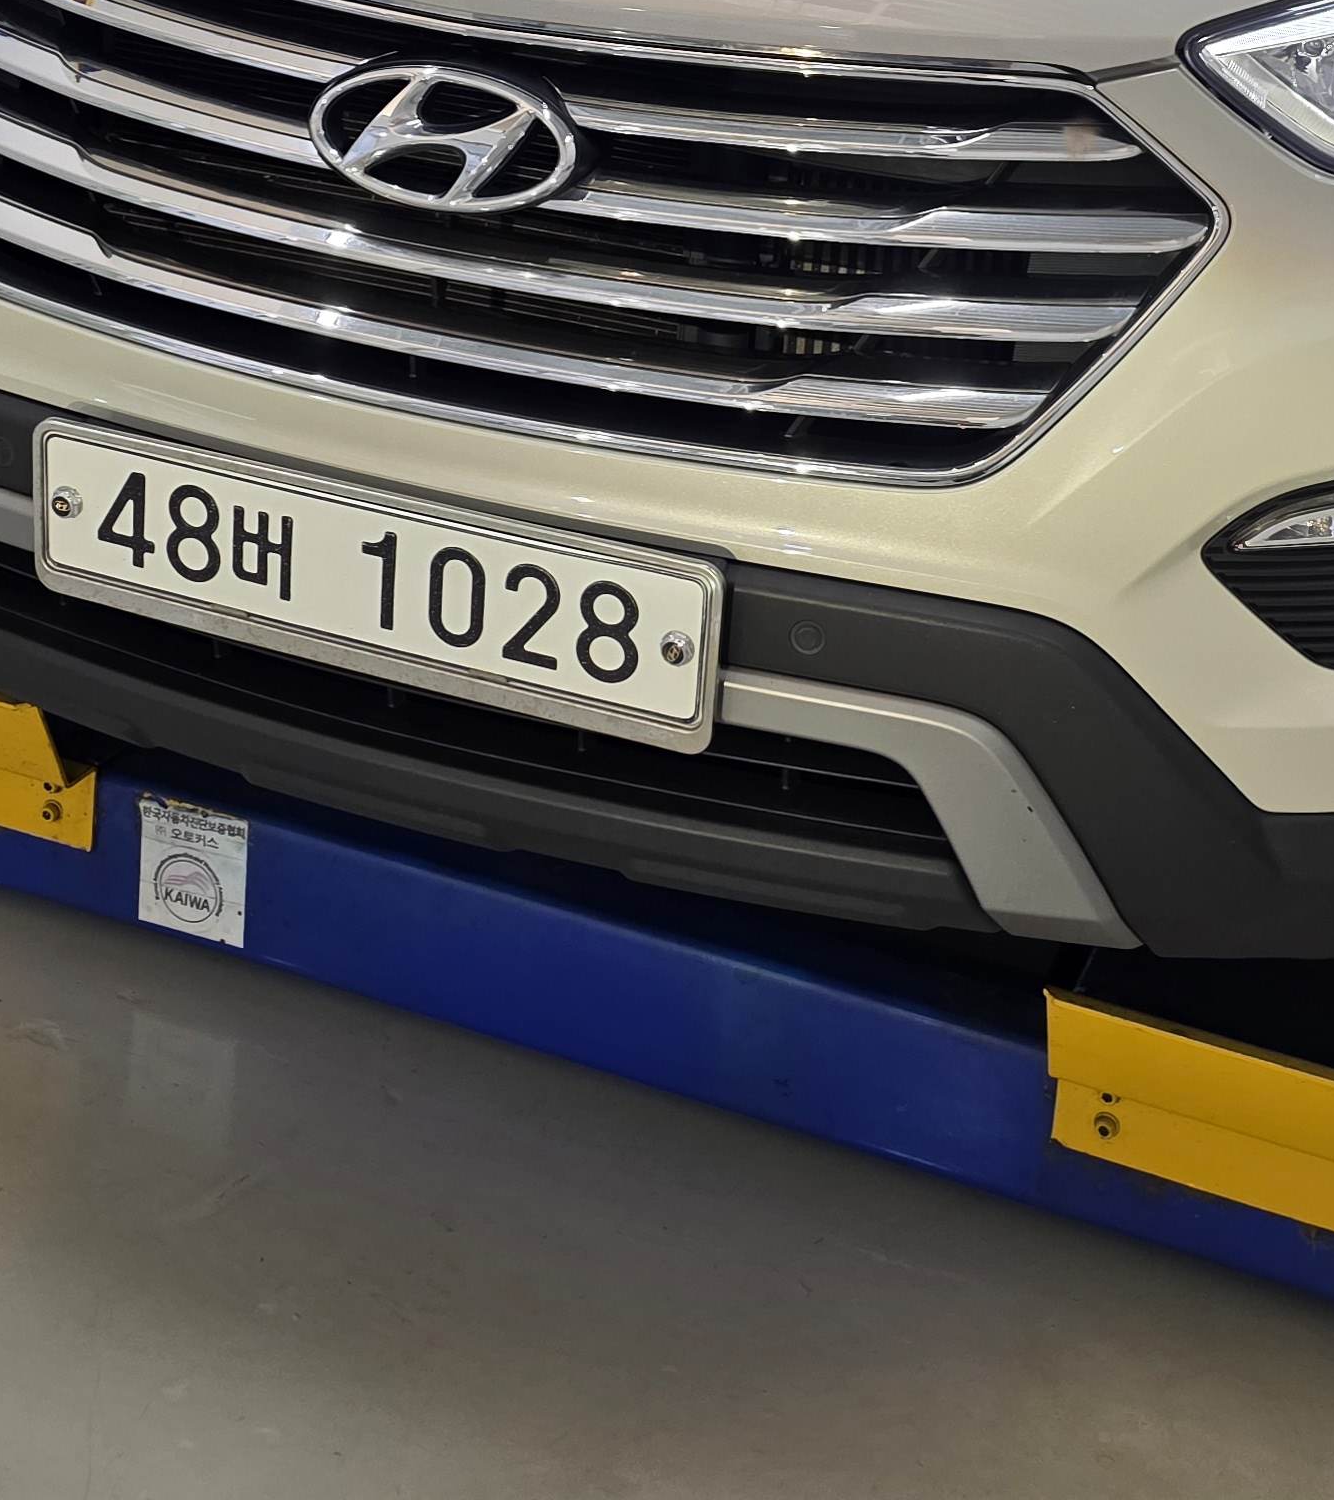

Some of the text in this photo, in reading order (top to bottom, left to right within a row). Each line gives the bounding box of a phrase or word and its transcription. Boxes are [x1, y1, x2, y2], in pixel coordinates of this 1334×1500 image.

[97, 471, 641, 684] 48버 1028
[164, 887, 210, 912] KAIWA
